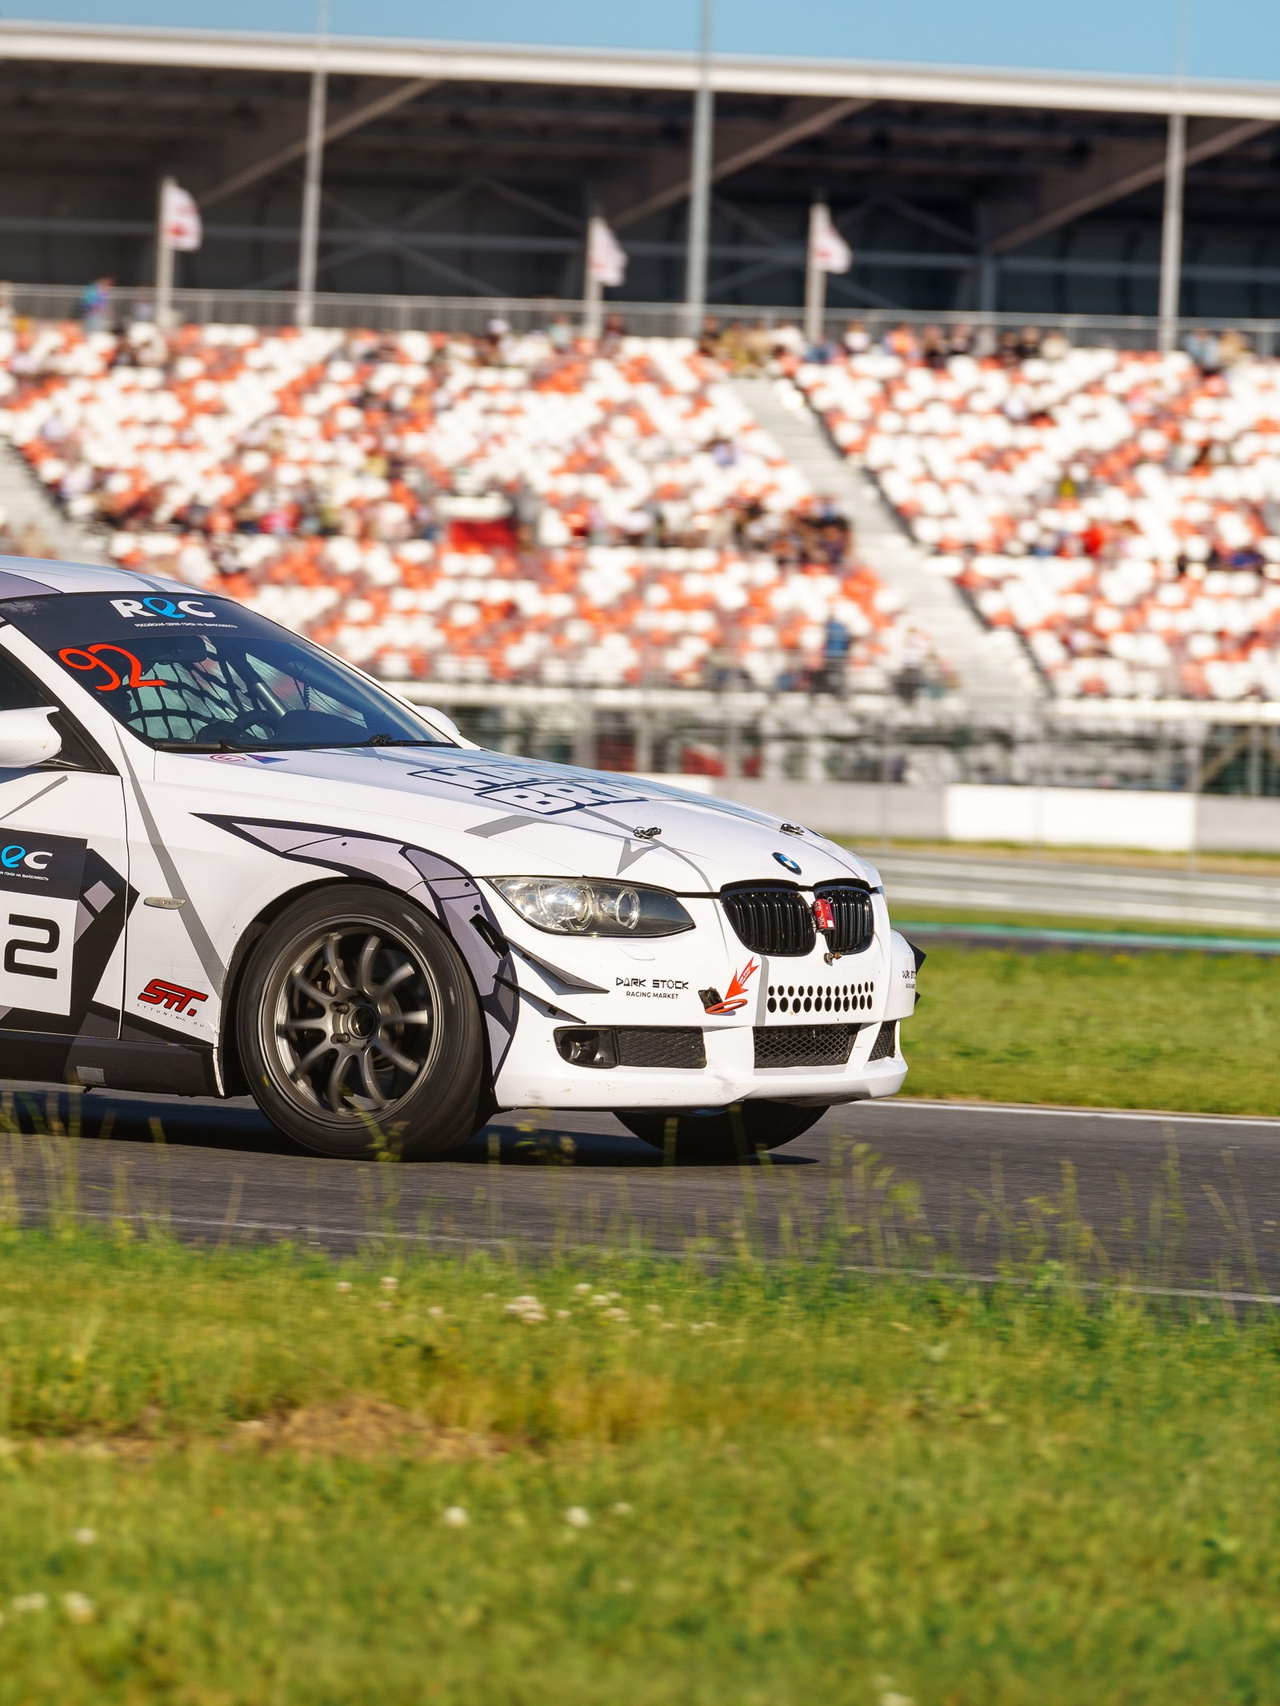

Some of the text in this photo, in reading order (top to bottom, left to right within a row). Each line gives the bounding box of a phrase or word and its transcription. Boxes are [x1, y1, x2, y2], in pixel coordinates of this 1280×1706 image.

[58, 643, 167, 691] 92
[615, 977, 689, 990] DARK STOCK
[626, 990, 679, 1000] RACING MARKET
